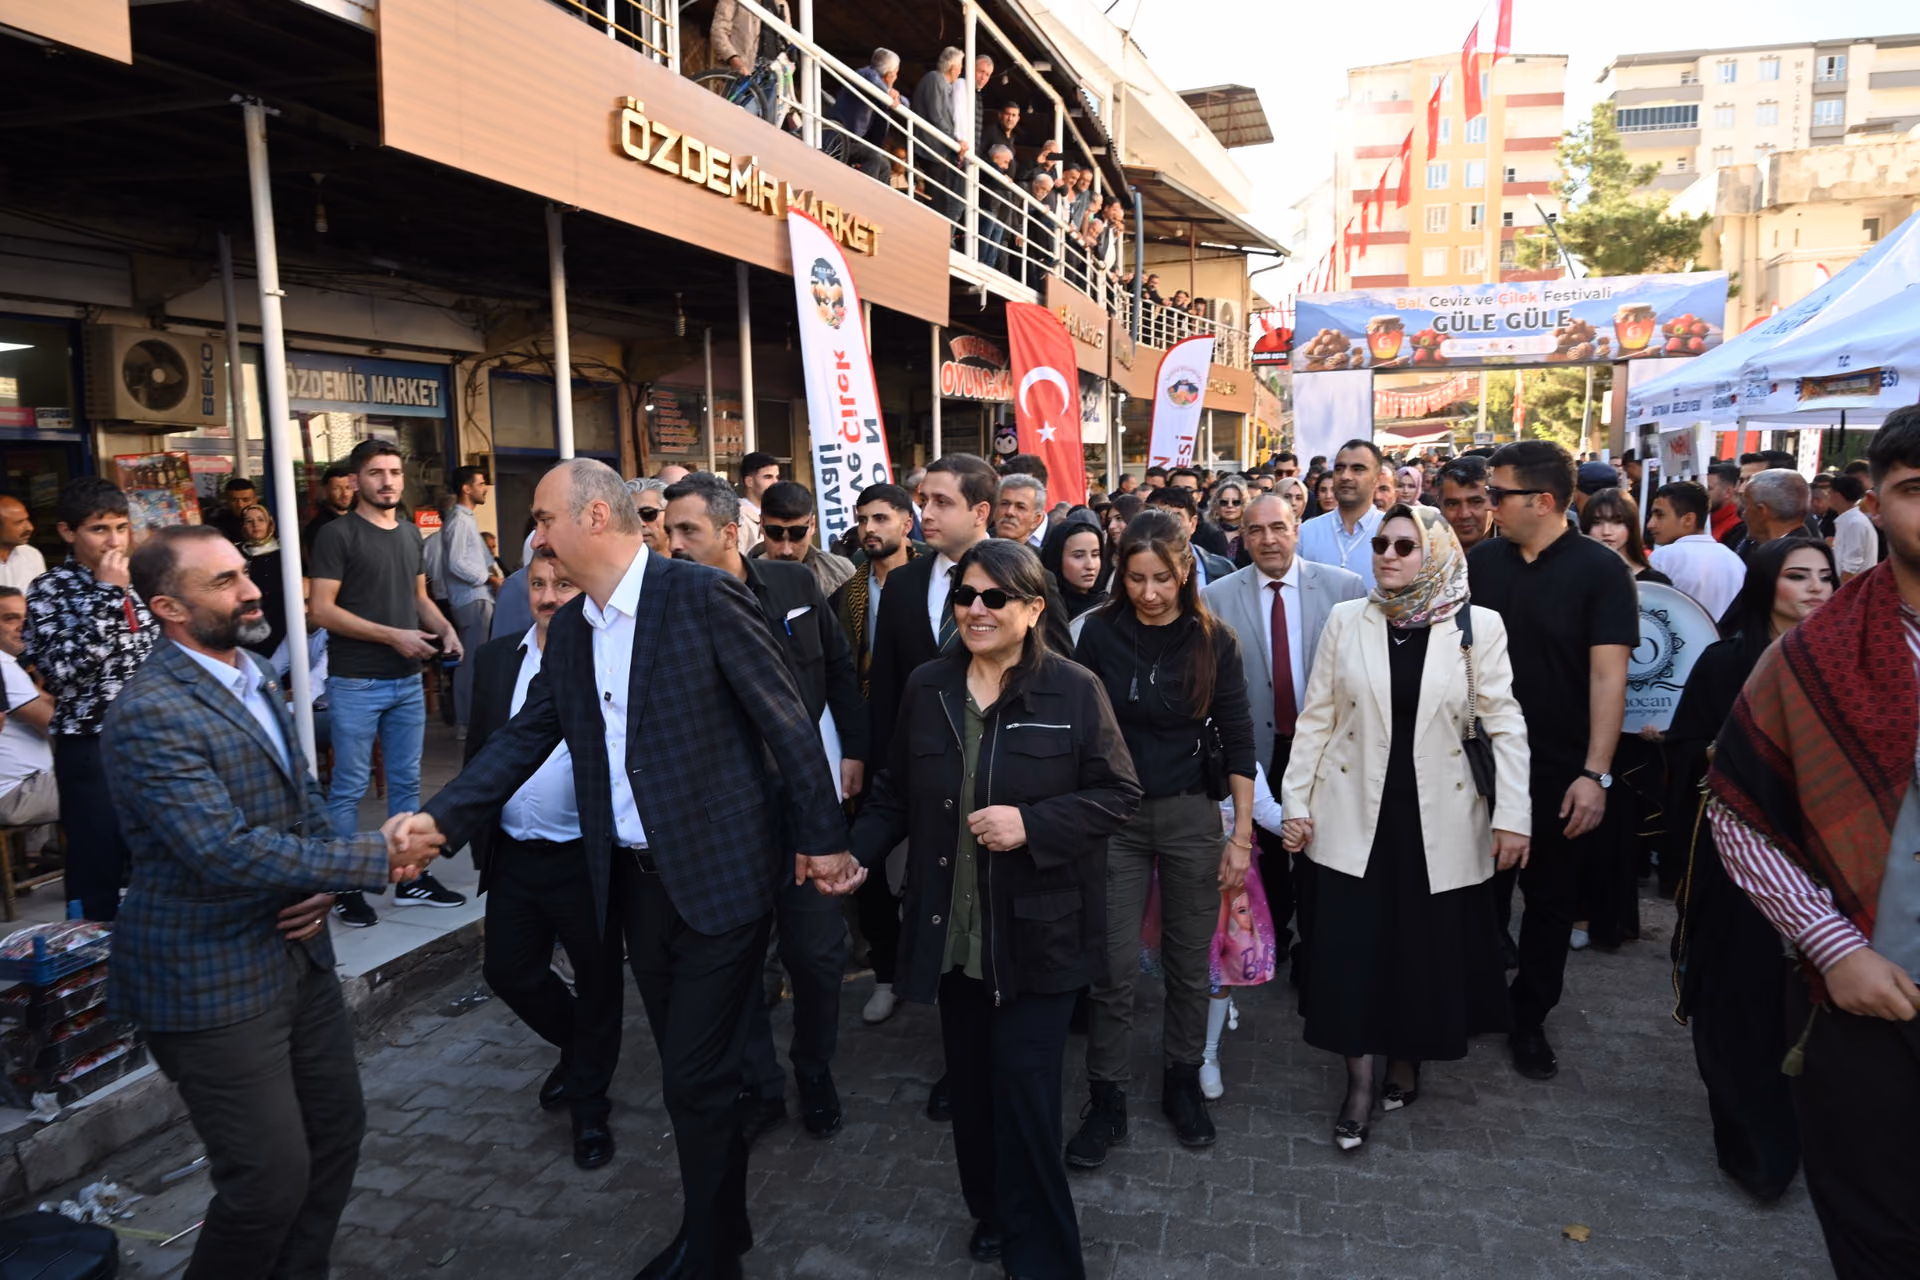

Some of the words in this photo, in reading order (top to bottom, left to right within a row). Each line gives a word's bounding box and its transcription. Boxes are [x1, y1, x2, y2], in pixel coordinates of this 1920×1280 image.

[611, 95, 780, 216] ÖZDEMİR
[780, 180, 882, 257] MARKET
[1395, 297, 1425, 310] Bal,
[1429, 293, 1471, 307] Ceviz
[1475, 296, 1493, 306] ve
[1498, 292, 1538, 309] Çilek
[1544, 286, 1612, 302] Festivali
[1432, 311, 1496, 333] GÜLE
[1505, 307, 1571, 330] GÜLE
[201, 343, 214, 416] BEKO
[286, 361, 367, 402] ÖZDEMİR
[371, 374, 439, 407] MARKET
